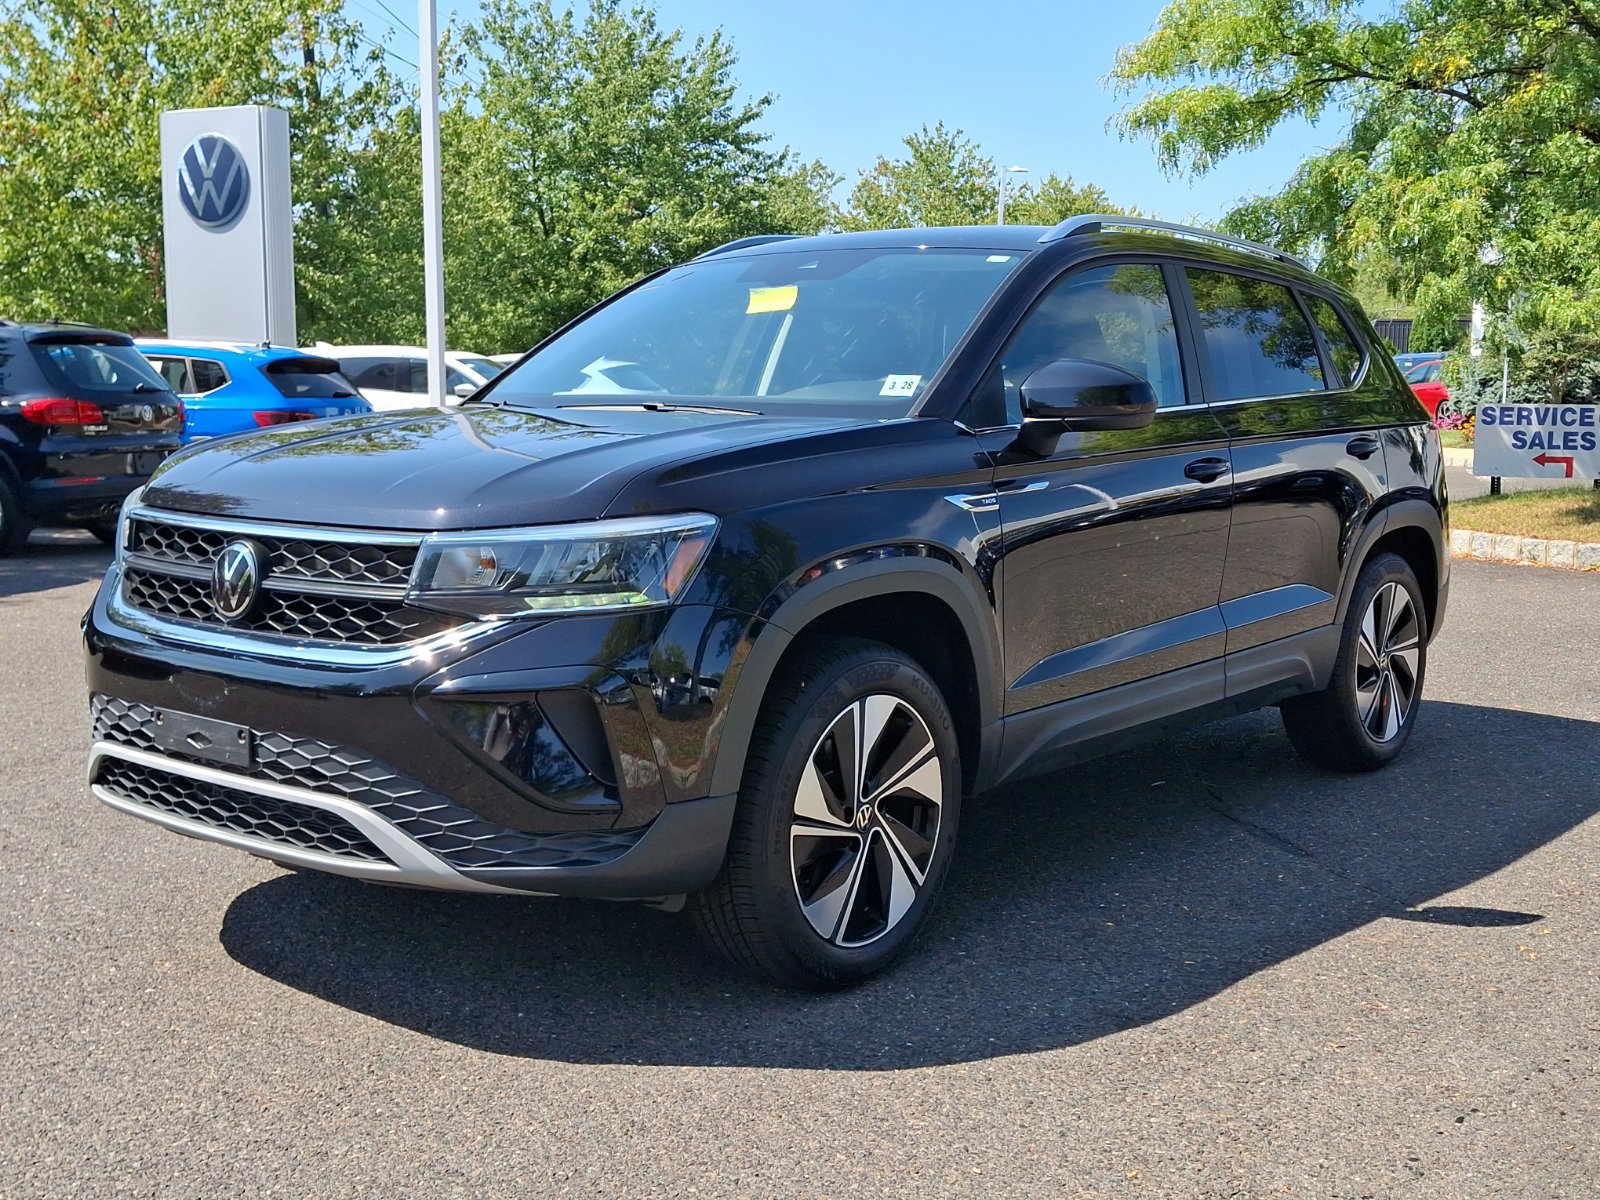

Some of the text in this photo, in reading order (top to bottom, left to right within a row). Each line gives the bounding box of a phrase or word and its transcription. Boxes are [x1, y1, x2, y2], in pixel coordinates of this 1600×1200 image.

[178, 135, 244, 221] VW
[888, 381, 897, 390] 3
[1481, 406, 1596, 427] SERVICE
[1511, 430, 1597, 451] SALES
[216, 544, 256, 613] VW
